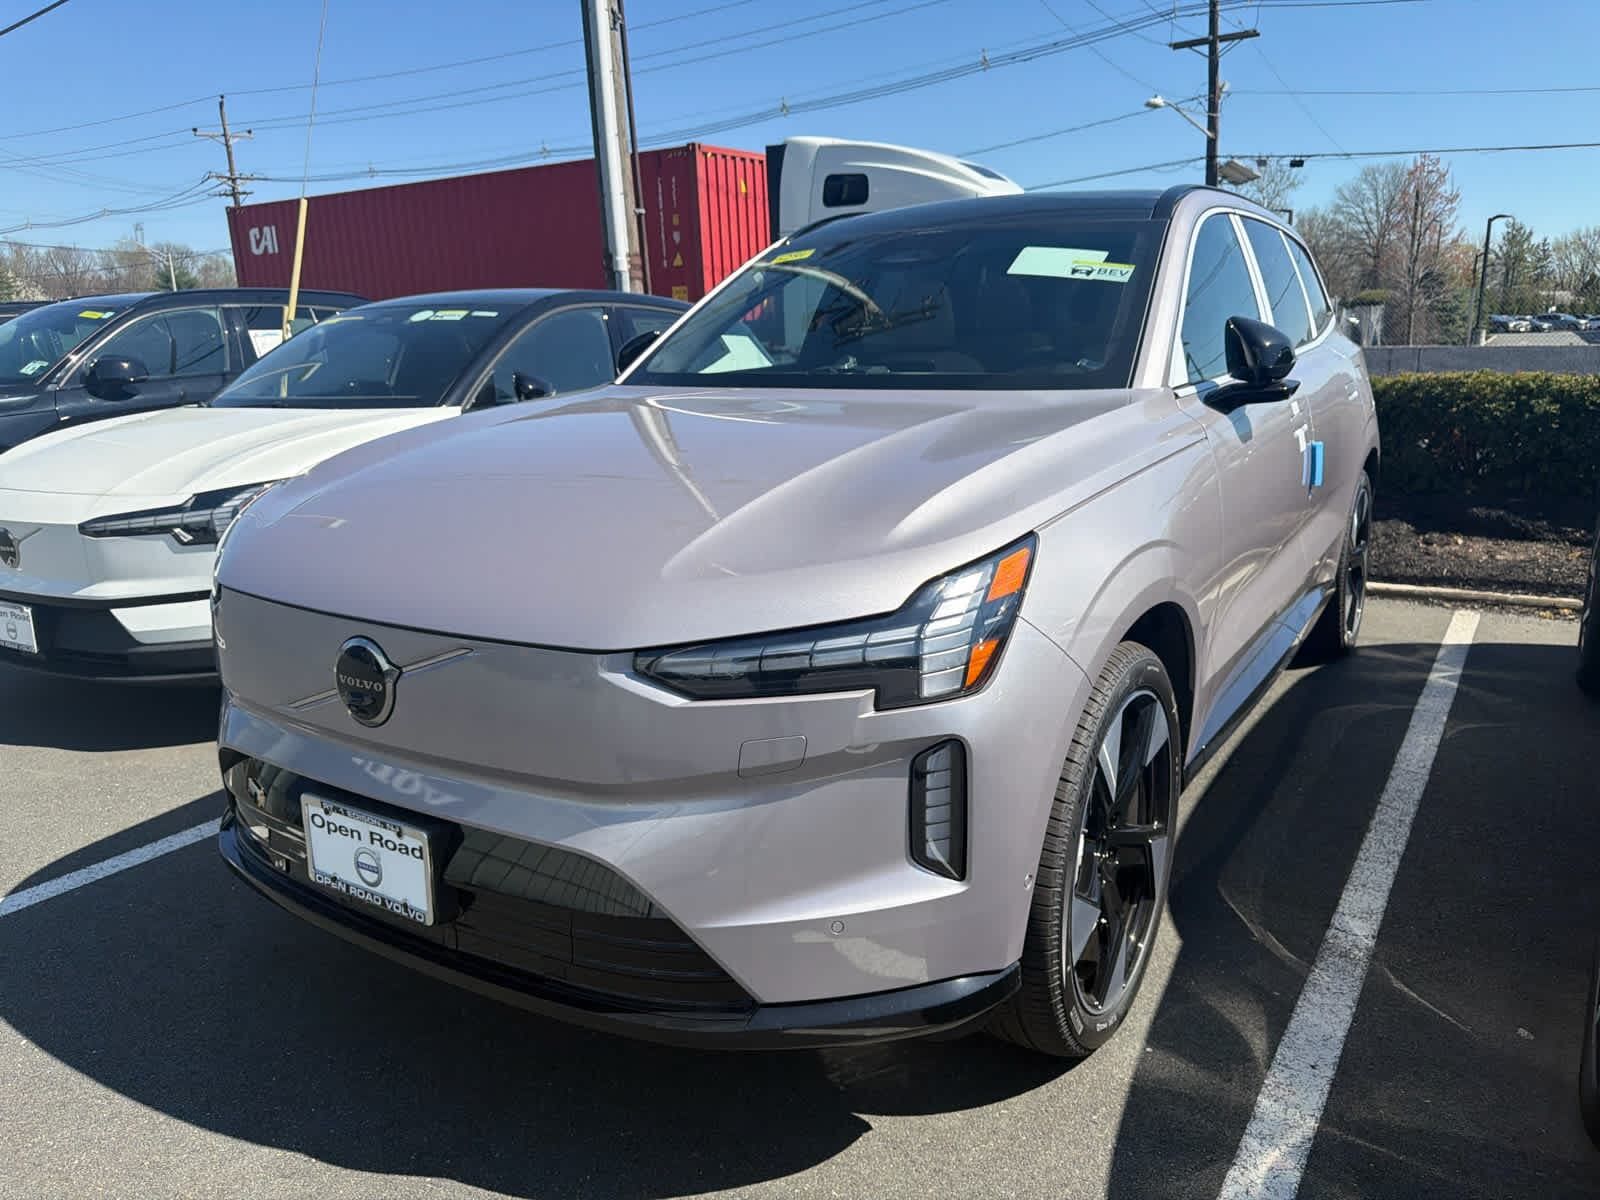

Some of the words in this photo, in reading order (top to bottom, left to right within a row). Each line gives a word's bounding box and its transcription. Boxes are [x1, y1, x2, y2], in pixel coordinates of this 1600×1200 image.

[249, 225, 279, 255] CAI
[1097, 267, 1129, 276] BEV
[340, 674, 383, 692] VOLVO
[311, 813, 362, 841] Open
[369, 831, 424, 860] Road
[349, 886, 381, 905] ROAD
[385, 901, 424, 922] VOLVO
